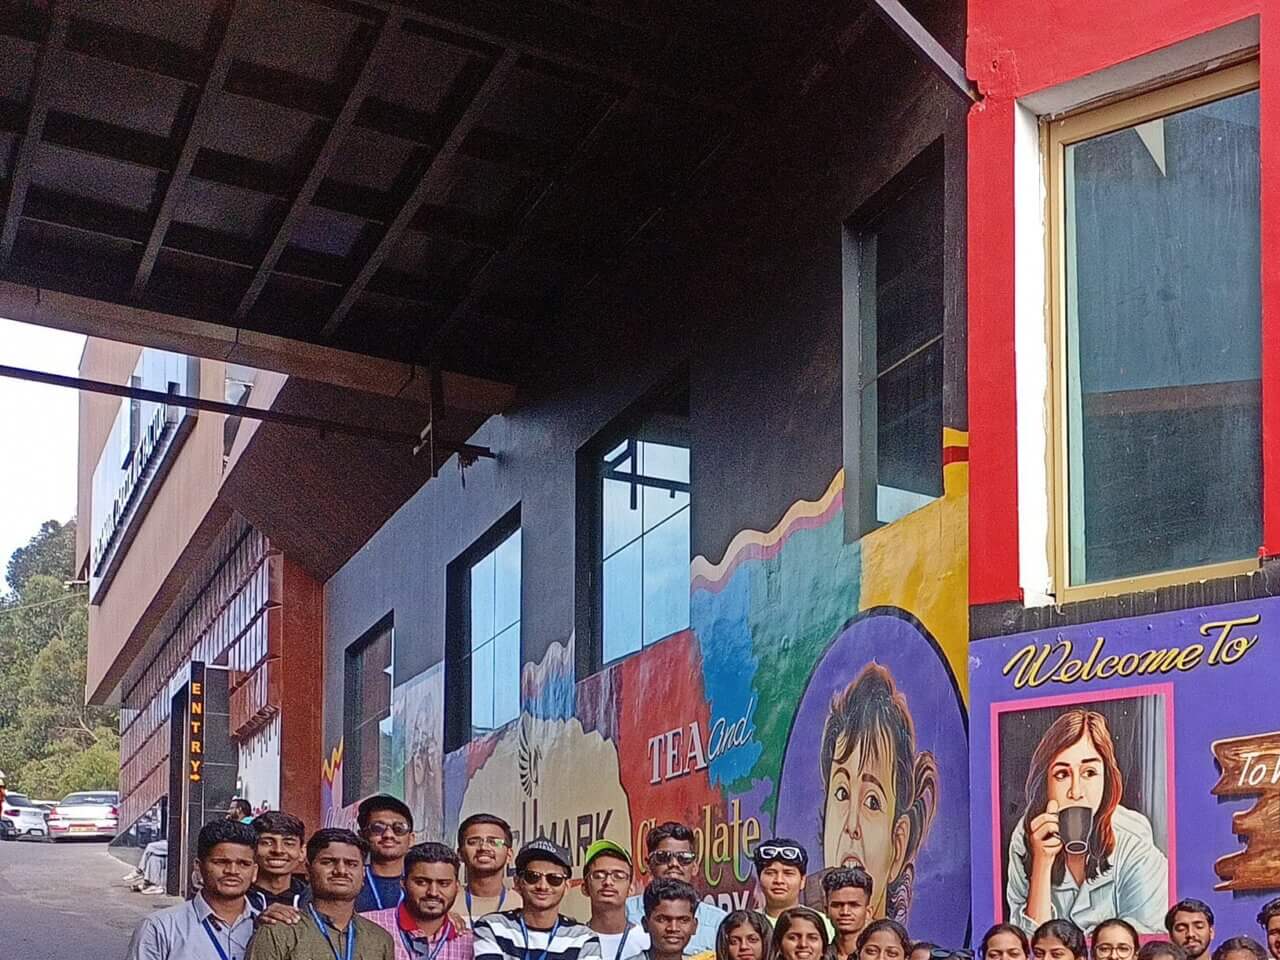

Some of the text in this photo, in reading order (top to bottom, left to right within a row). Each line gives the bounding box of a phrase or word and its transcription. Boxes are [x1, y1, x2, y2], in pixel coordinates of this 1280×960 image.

[1002, 614, 1260, 689] Welcome To
[190, 682, 203, 772] ENTRY
[647, 721, 708, 785] TEA
[1238, 752, 1267, 787] To
